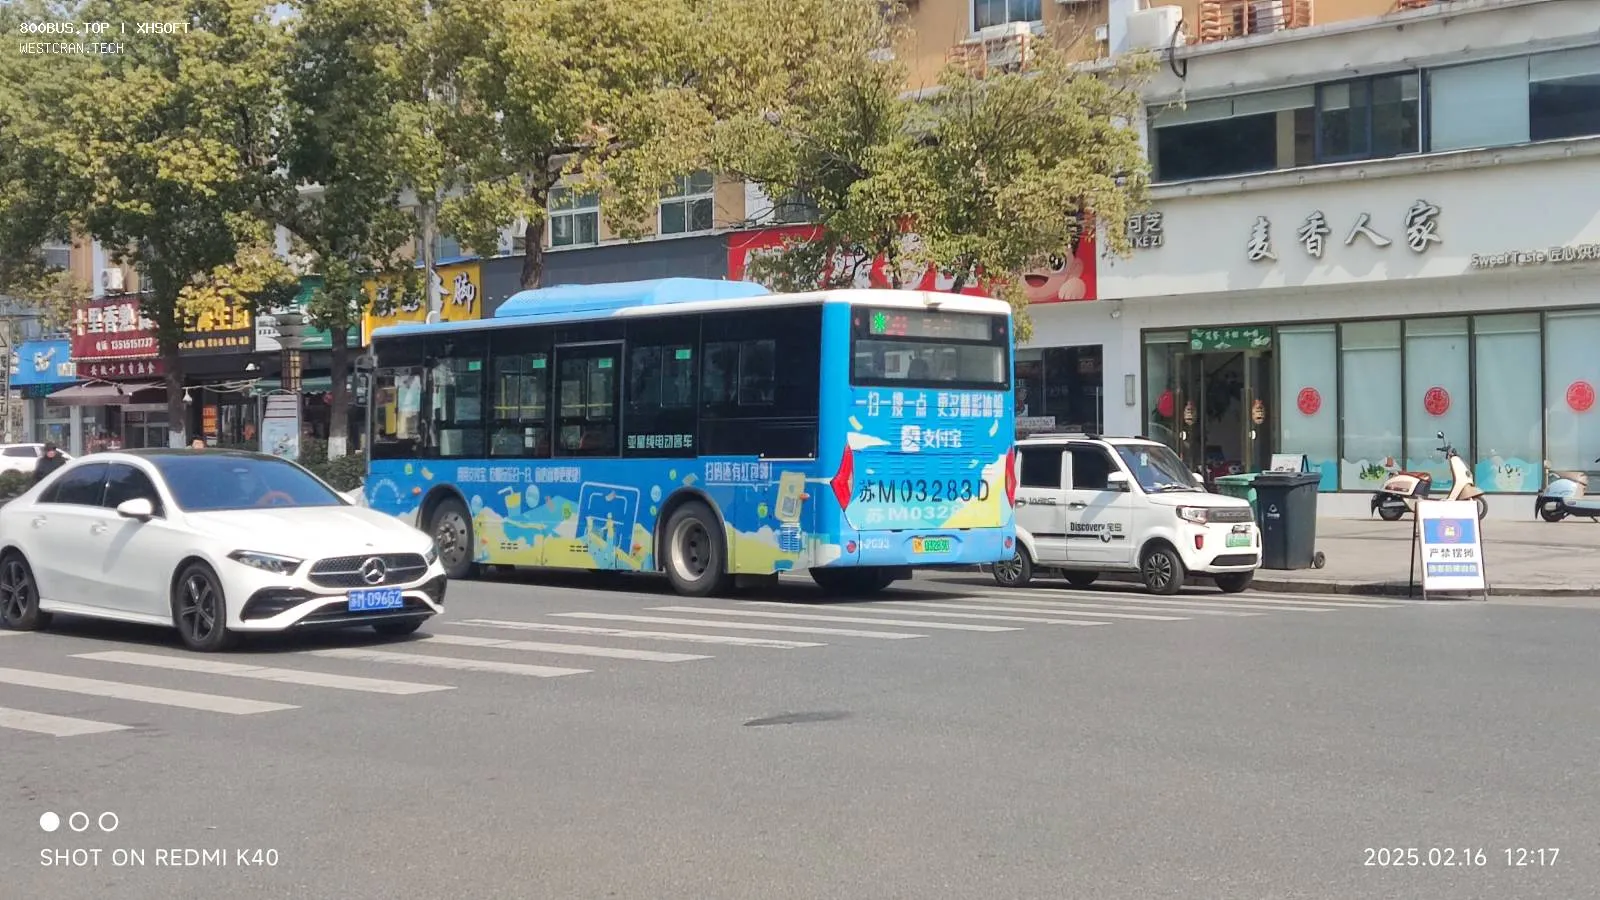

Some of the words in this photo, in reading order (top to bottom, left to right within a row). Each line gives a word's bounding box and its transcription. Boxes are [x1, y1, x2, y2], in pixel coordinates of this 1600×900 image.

[1247, 199, 1443, 263] 麦香人家
[1471, 250, 1508, 267] Sweet
[922, 428, 963, 449] 支付宝
[860, 479, 990, 503] 苏M03283D
[1070, 522, 1105, 532] Discovery
